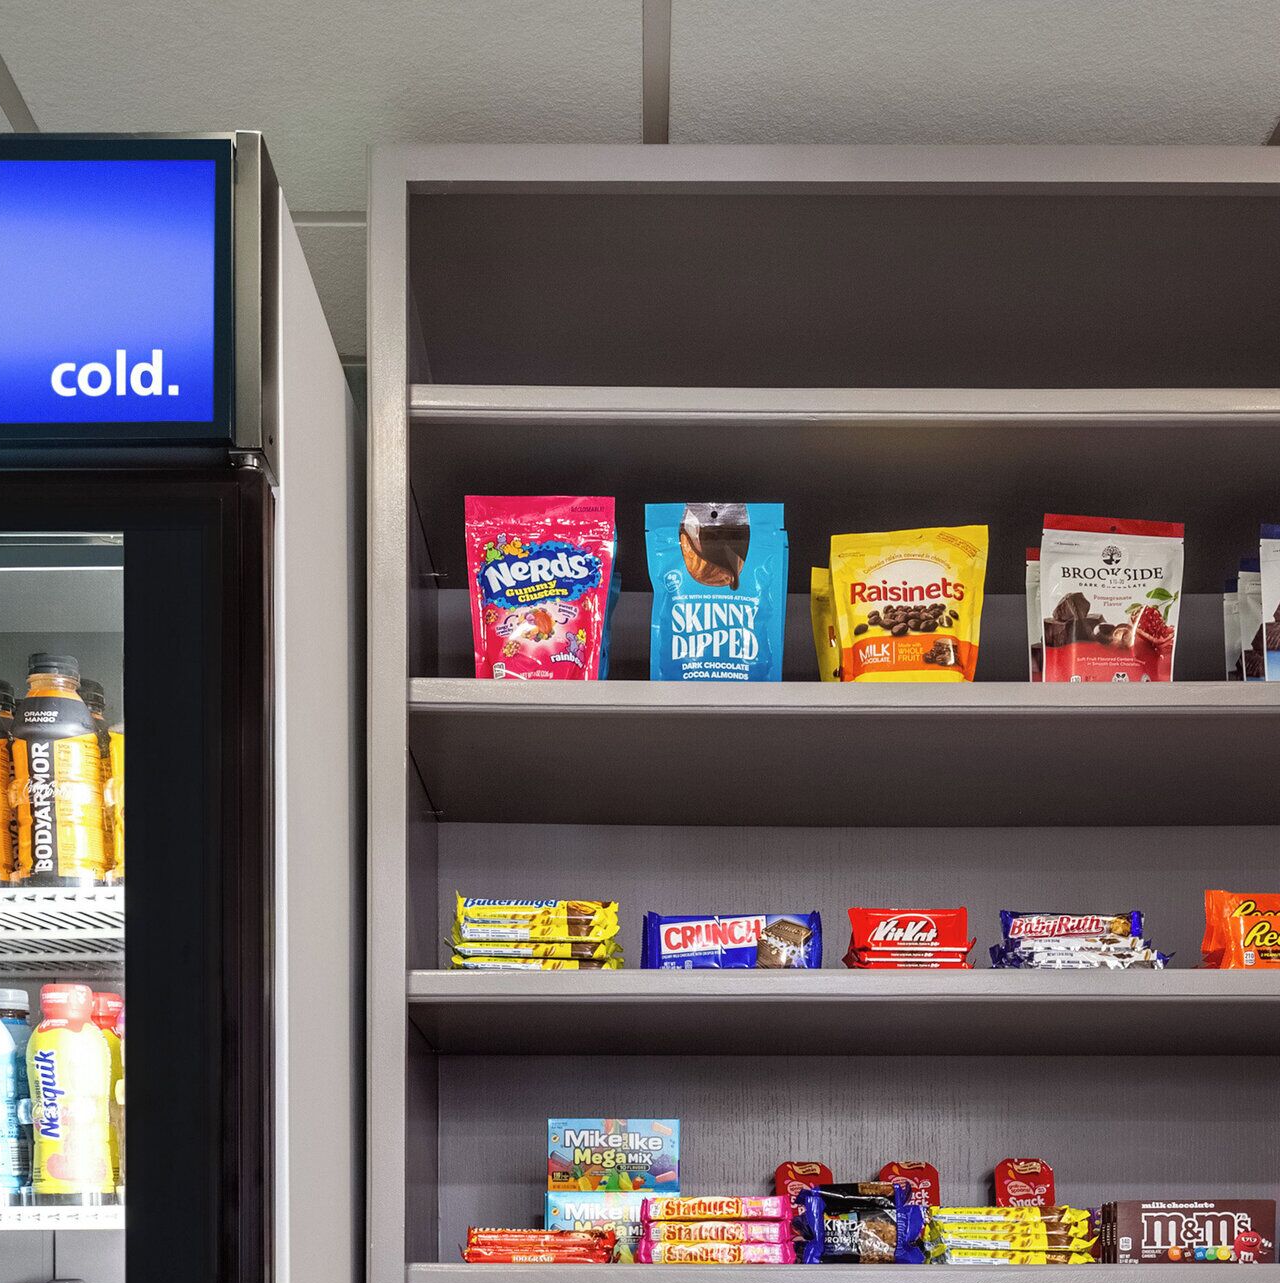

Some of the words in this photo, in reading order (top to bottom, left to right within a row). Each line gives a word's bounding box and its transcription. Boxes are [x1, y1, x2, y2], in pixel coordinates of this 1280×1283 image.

[51, 349, 179, 396] cold.
[505, 581, 557, 597] Gummy
[518, 588, 568, 603] Clusters
[850, 578, 965, 604] Raisinets
[672, 604, 759, 633] SKINNY
[672, 628, 759, 660] DIPPED
[859, 643, 890, 660] MILK
[682, 663, 702, 671] DARK
[704, 663, 749, 671] CHOCOLATE
[711, 672, 748, 680] ALMONDS
[664, 920, 762, 951] CRUNCH
[34, 1050, 64, 1138] Nesquik
[564, 1130, 621, 1148] Mike
[629, 1132, 663, 1150] Ike
[574, 1149, 627, 1167] Mega
[664, 1198, 742, 1217] Starburst
[665, 1222, 745, 1242] Starburst
[824, 1219, 858, 1233] KIND
[1141, 1212, 1251, 1249] m&m's
